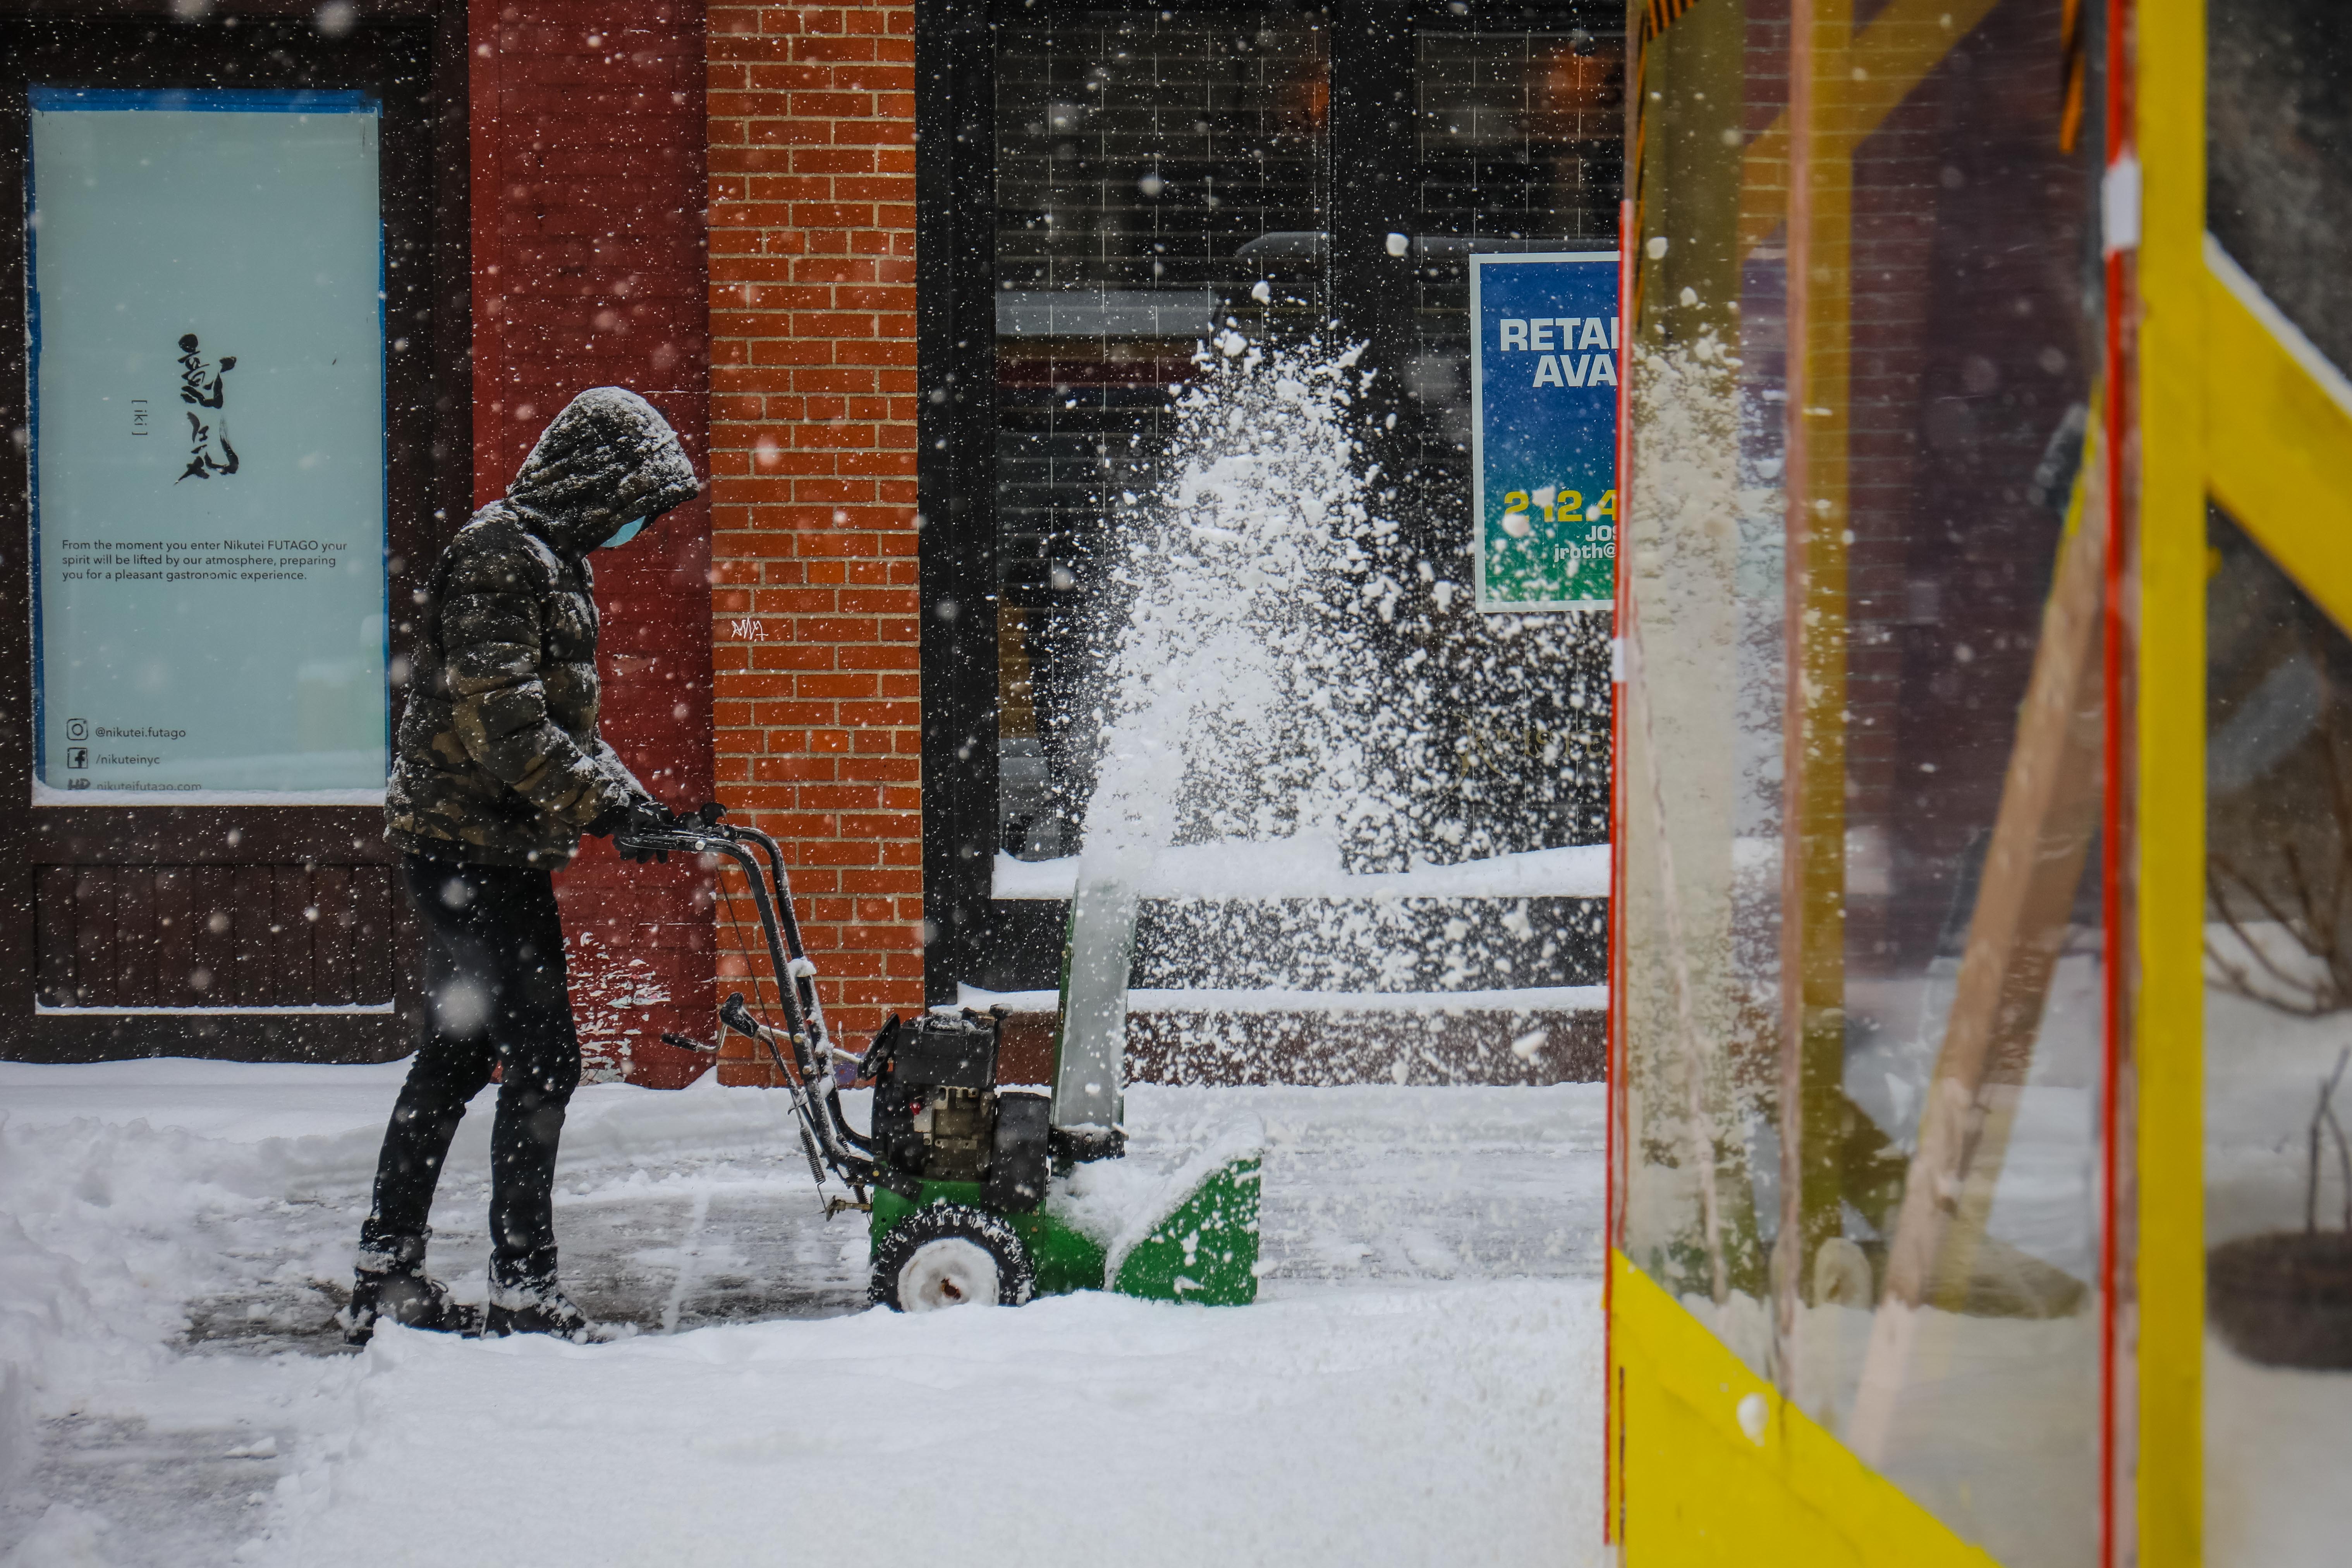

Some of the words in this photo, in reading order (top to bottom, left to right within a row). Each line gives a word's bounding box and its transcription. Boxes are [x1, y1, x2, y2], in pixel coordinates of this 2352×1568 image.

[1532, 354, 1618, 387] AVA
[62, 540, 90, 550] From
[94, 540, 112, 550] the
[116, 541, 163, 550] moment
[167, 543, 187, 552] you
[191, 541, 220, 550] enter
[224, 540, 264, 550] Nikutei
[268, 540, 318, 550] FUTAGO
[322, 543, 347, 553] your
[1554, 542, 1617, 562] jroth@
[62, 555, 90, 566] spirit
[93, 554, 112, 564] will
[116, 554, 130, 564] be
[134, 554, 161, 564] lifted
[166, 554, 179, 567] by
[206, 555, 276, 567] atmosphere,
[280, 556, 335, 567] preparing
[62, 571, 82, 581] you
[86, 569, 102, 579] for
[115, 569, 163, 581] pleasant
[167, 570, 237, 581] gastronomic
[241, 570, 307, 581] experience.
[96, 727, 186, 739] @nikutei.futago
[96, 754, 160, 767] /nikuteinyc
